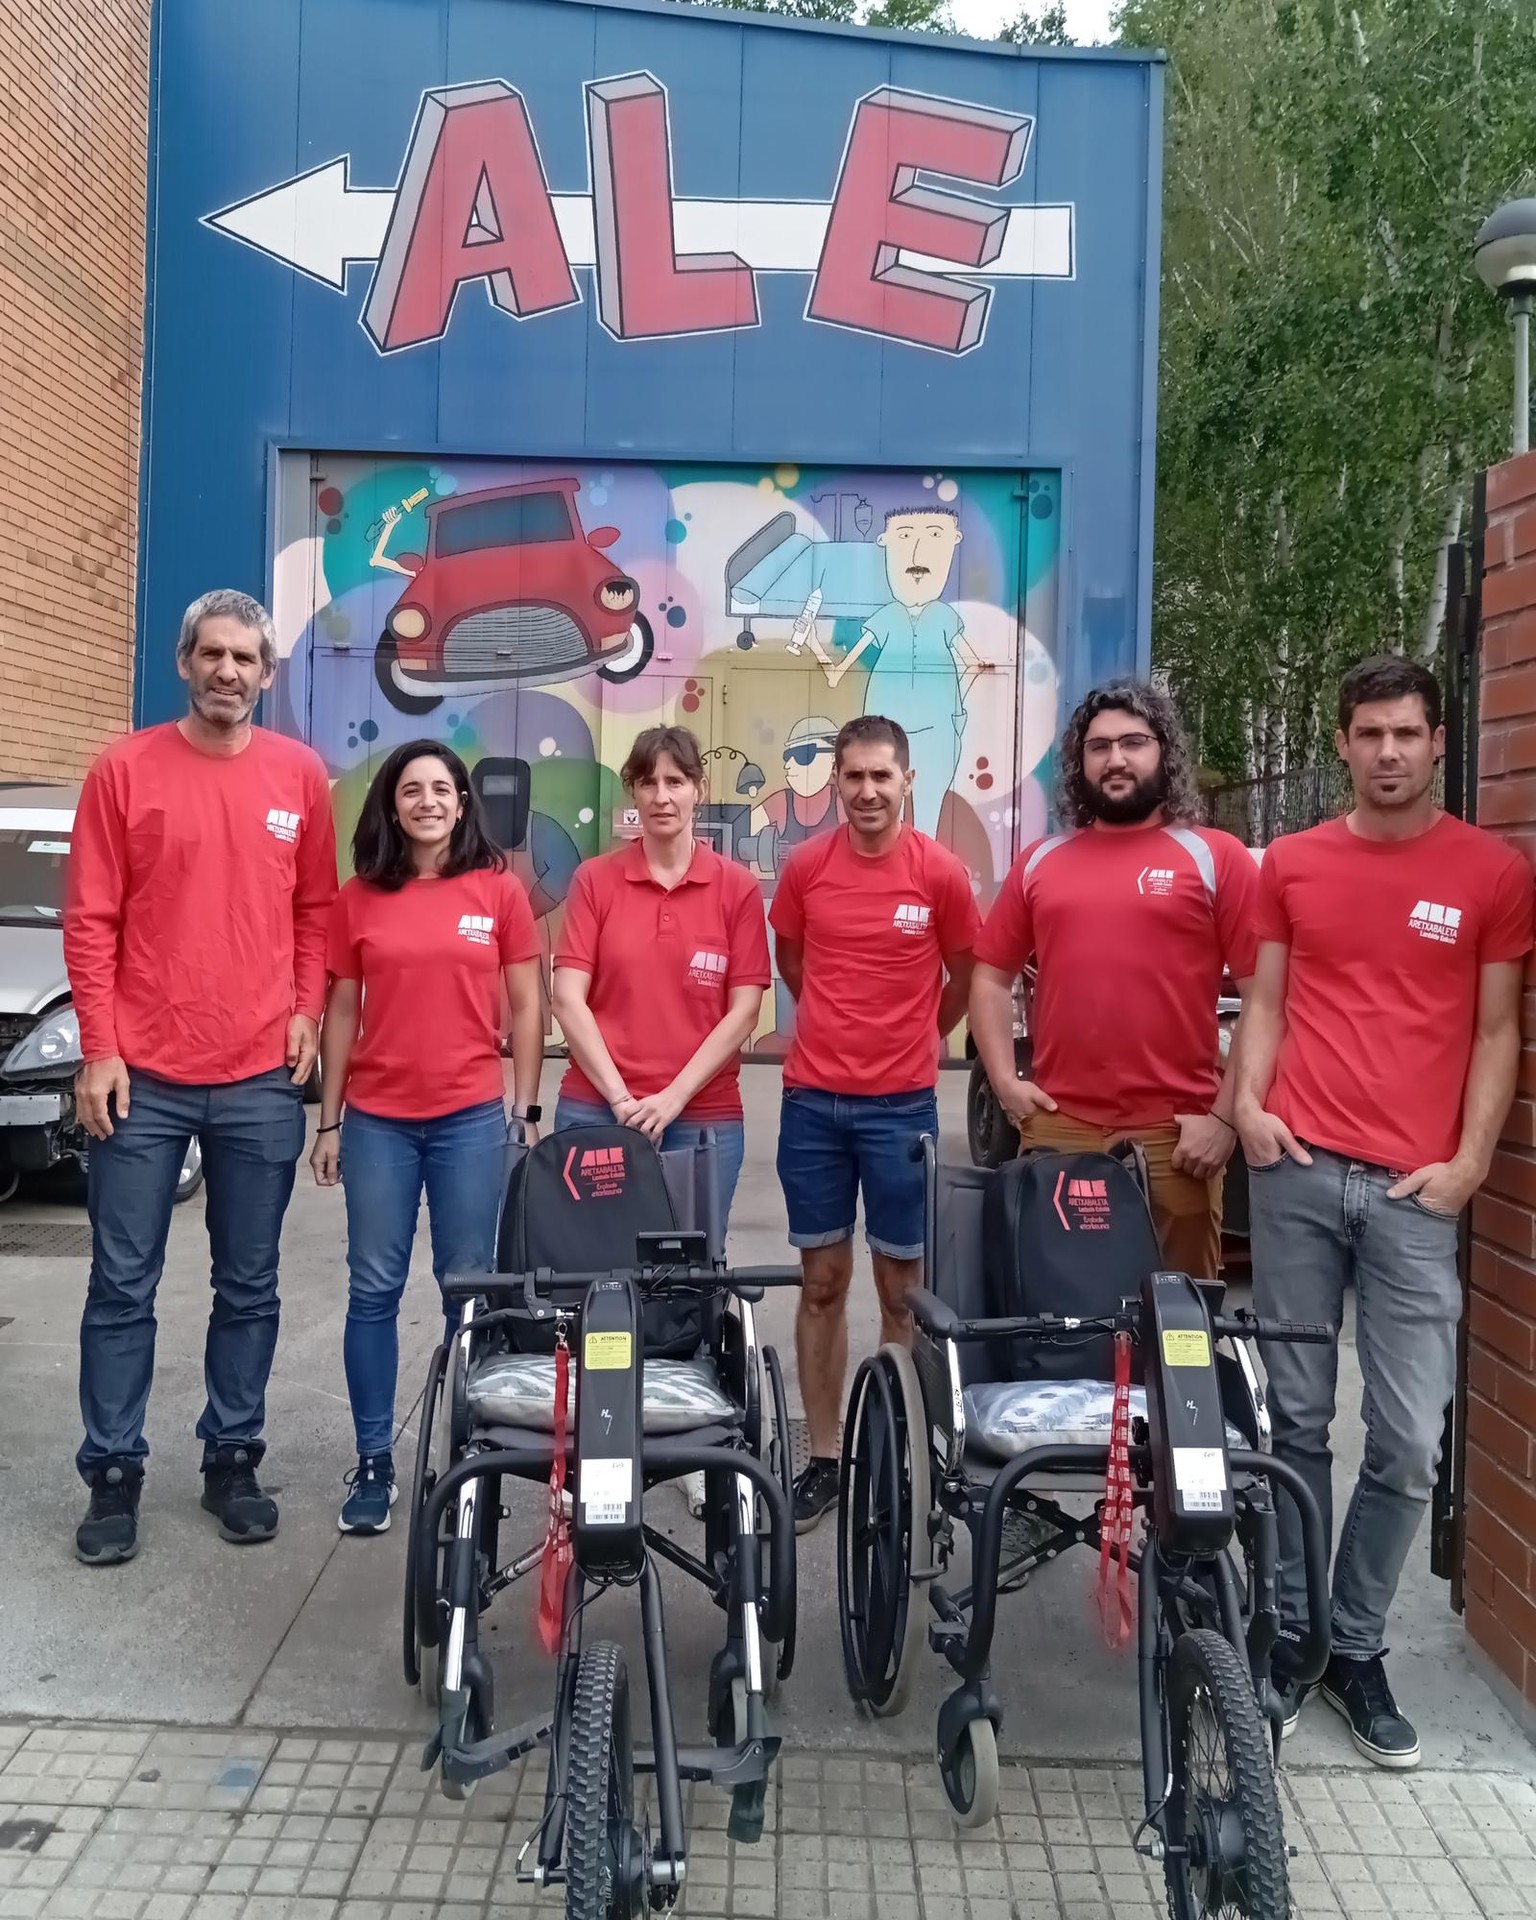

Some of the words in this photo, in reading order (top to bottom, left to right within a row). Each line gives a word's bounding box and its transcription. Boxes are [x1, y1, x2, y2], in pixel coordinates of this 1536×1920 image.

[358, 70, 1036, 357] ALE
[1409, 900, 1462, 929] ALE
[580, 1147, 624, 1168] ALE
[1068, 1179, 1107, 1197] ALE
